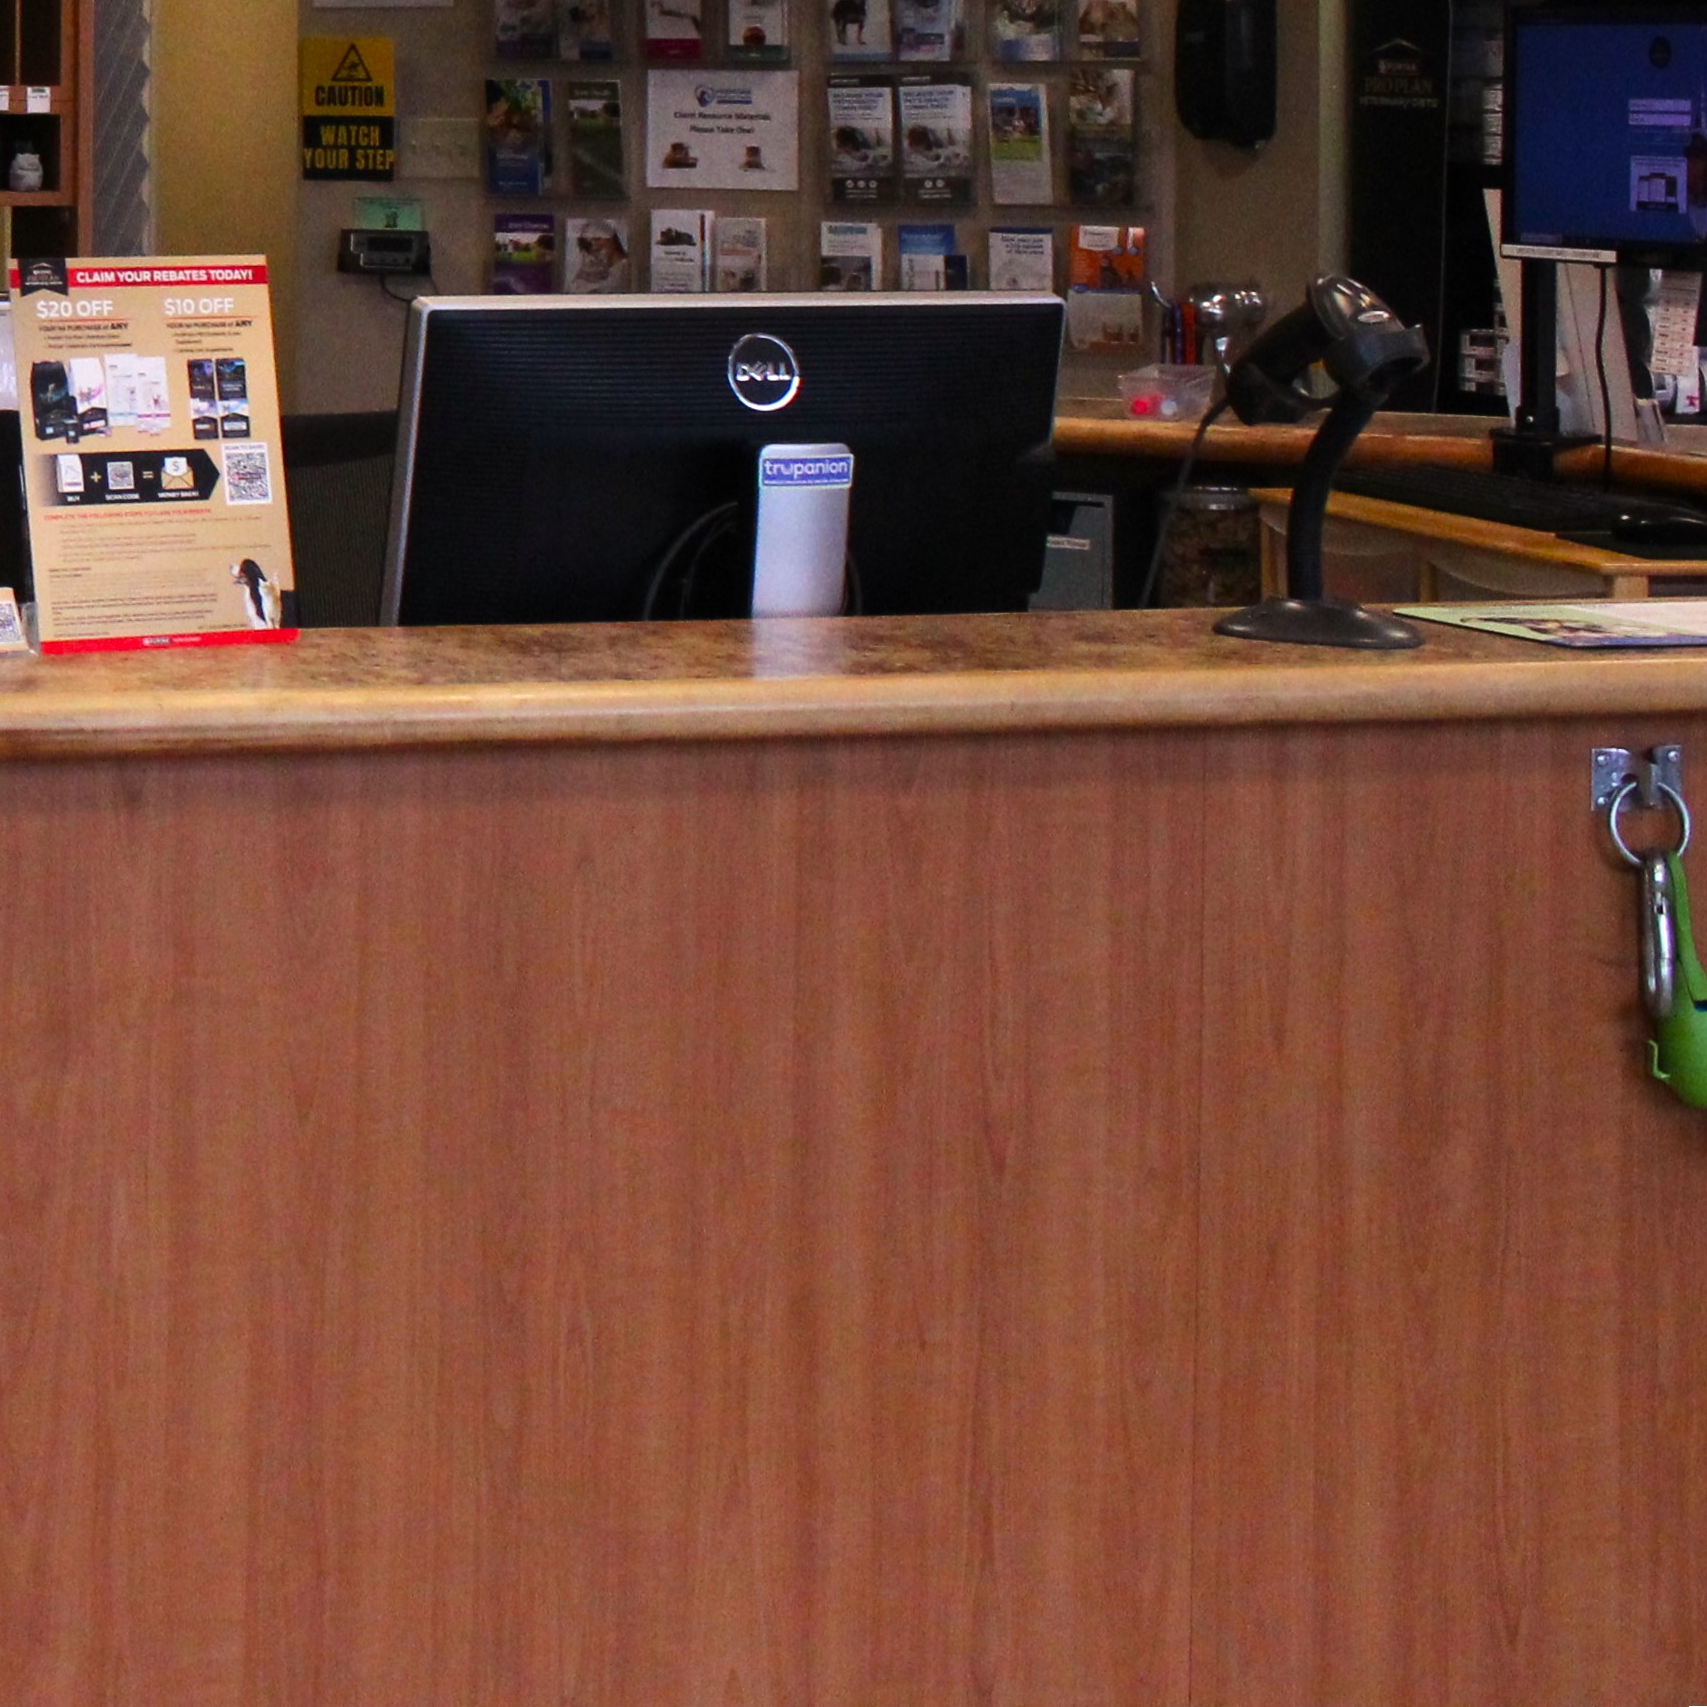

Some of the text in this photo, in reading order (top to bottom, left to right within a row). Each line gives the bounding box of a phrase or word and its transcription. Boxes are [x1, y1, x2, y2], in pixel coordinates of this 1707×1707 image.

[315, 85, 384, 107] CAUTION
[320, 125, 380, 146] WATCH
[304, 148, 394, 170] YOUR STEP
[76, 272, 116, 283] CLAIM
[117, 271, 152, 282] YOUR
[153, 270, 207, 281] REBATES
[208, 269, 253, 281] TODAY!
[36, 300, 113, 318] $20 OFF
[163, 297, 234, 316] $10 OFF
[736, 362, 791, 381] DELL
[764, 460, 848, 480] trupanion
